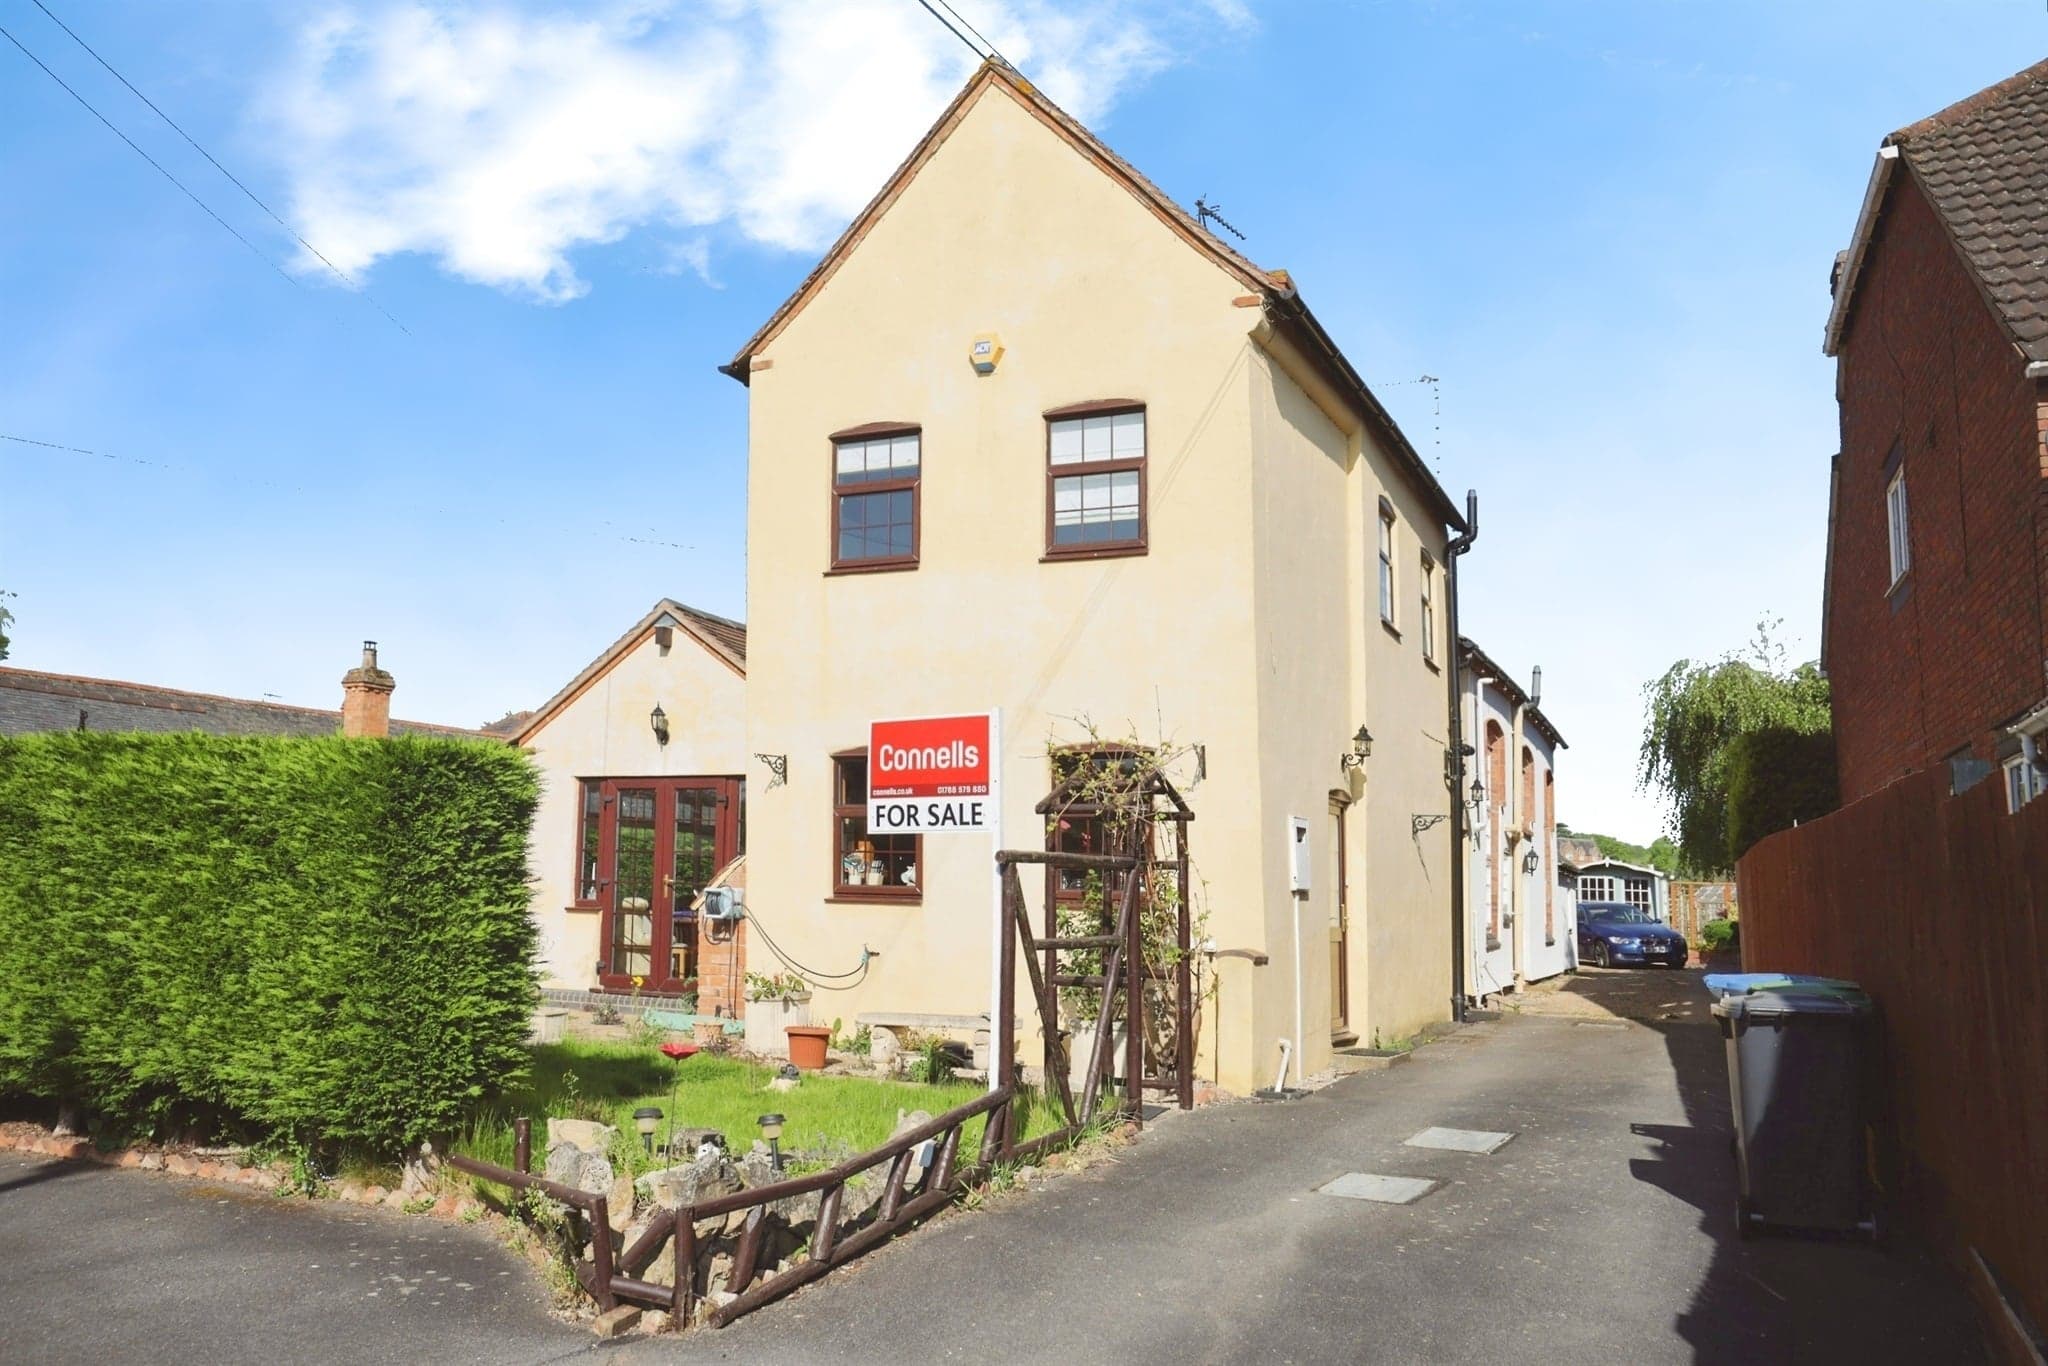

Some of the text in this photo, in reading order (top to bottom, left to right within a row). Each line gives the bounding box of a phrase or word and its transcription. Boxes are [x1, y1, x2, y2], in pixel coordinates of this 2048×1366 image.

[879, 740, 979, 771] Connells
[875, 802, 983, 827] FOR SALE
